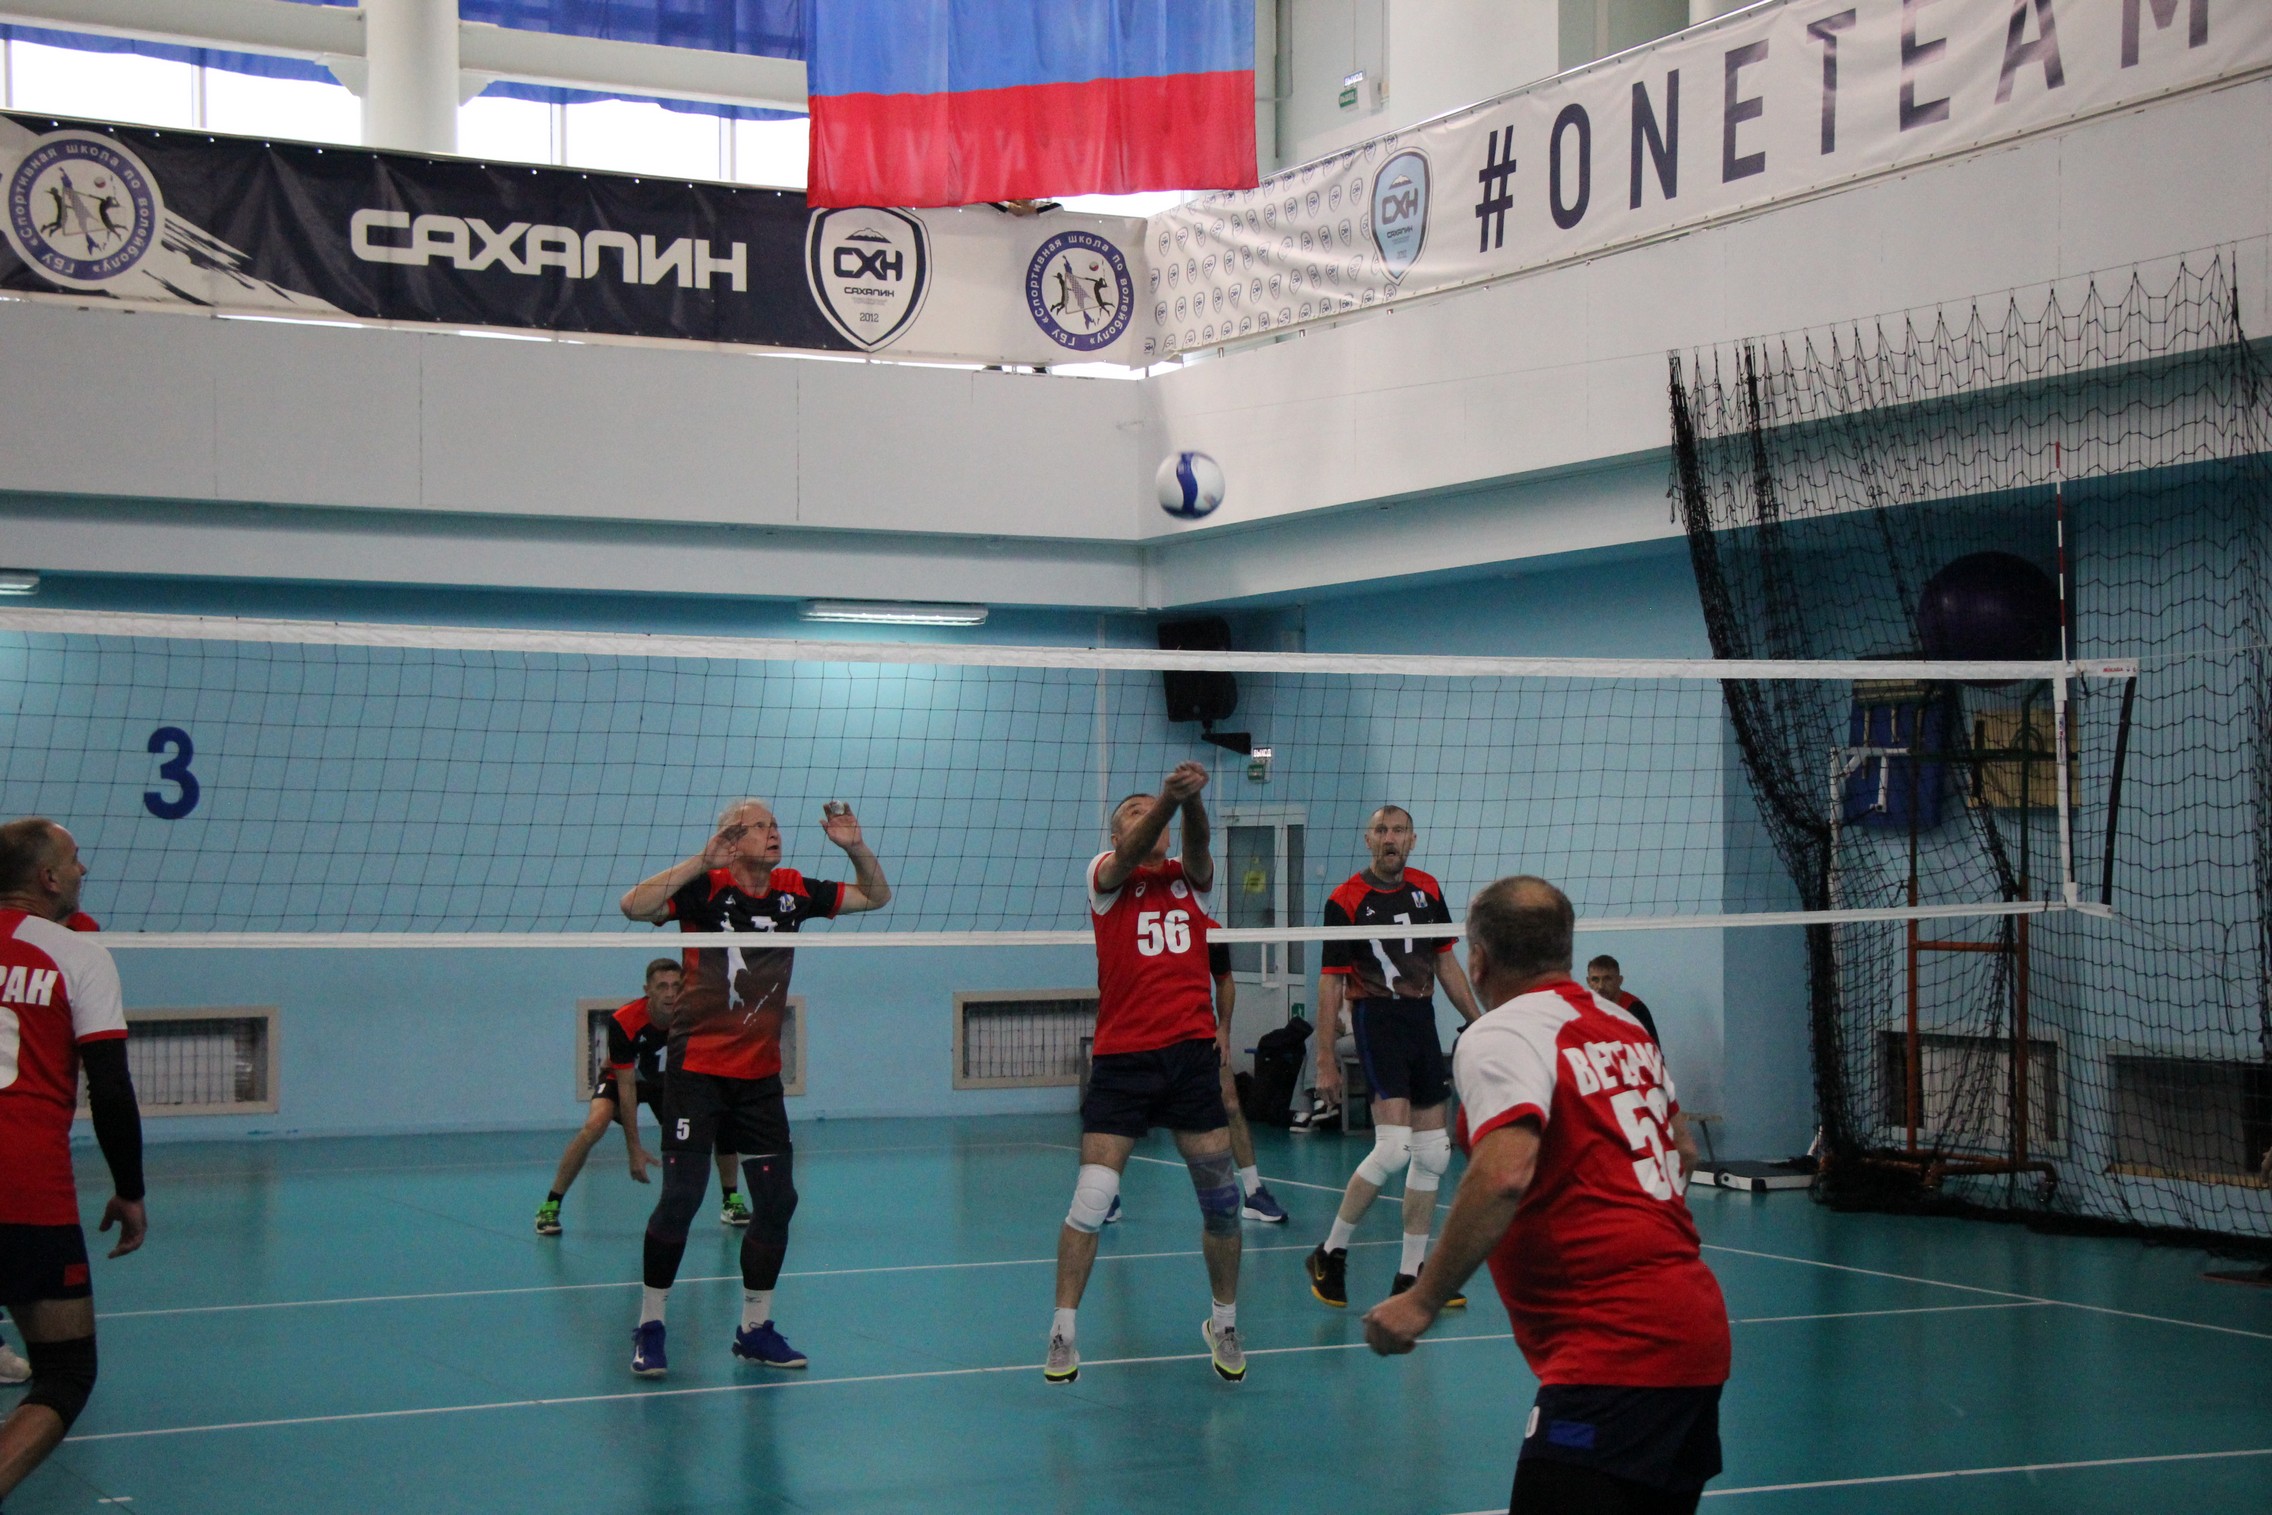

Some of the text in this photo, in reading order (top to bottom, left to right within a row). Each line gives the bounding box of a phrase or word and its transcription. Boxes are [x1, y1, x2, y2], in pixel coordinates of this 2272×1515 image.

[42, 253, 76, 274] ГБУ
[66, 144, 120, 166] школа
[124, 169, 141, 189] по
[350, 208, 748, 292] САХАЛИН
[844, 286, 895, 298] САХАЛИН
[859, 312, 879, 322] 2012
[1052, 329, 1076, 346] ГБУ
[1068, 235, 1109, 252] школа
[1112, 254, 1123, 271] по
[143, 726, 200, 820] 3
[1137, 909, 1191, 957] 56
[676, 1118, 690, 1140] 5
